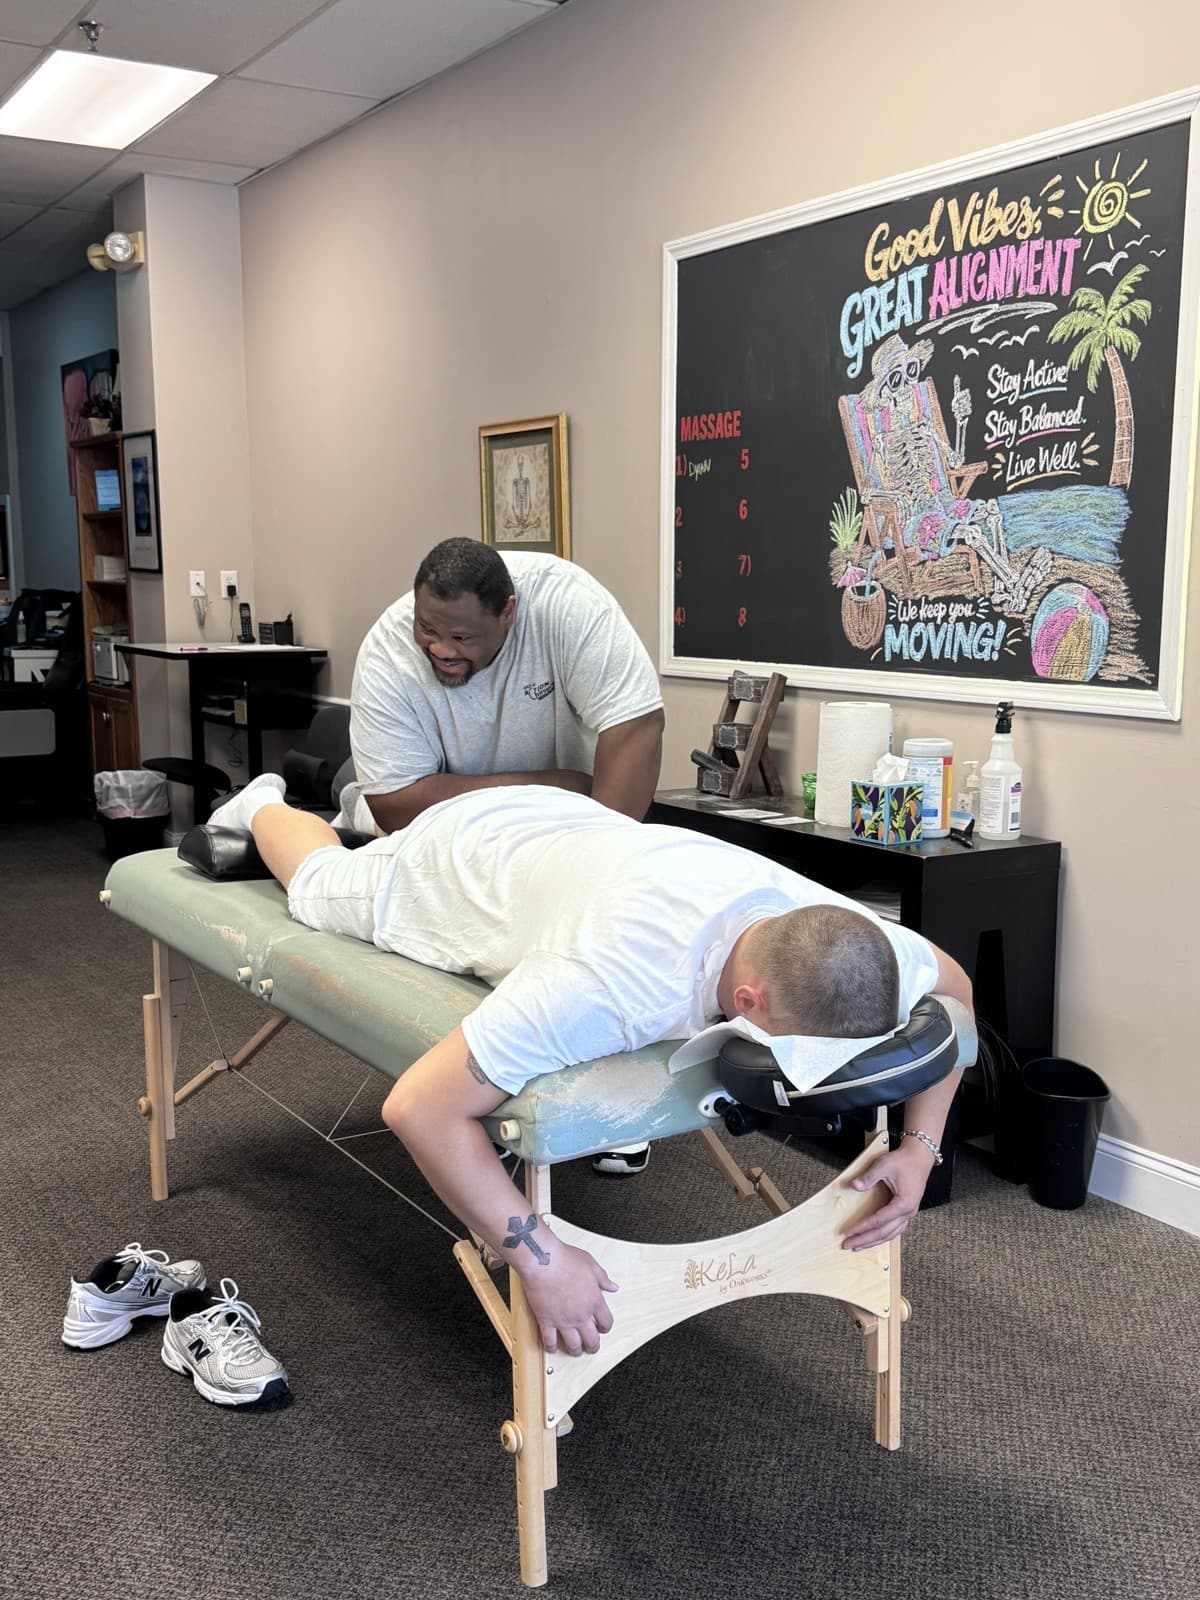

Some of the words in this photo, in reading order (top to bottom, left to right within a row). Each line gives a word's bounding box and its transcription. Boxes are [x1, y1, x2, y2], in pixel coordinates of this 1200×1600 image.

[864, 198, 946, 282] Good
[947, 187, 1042, 252] Vibes,
[840, 264, 929, 379] GREAT
[928, 237, 1082, 321] ALIGNMENT
[986, 364, 1021, 405] Stay
[680, 410, 742, 442] MASSAGE
[984, 410, 1018, 448] Stay
[1018, 395, 1087, 435] Balanced.
[741, 449, 750, 470] 5
[1006, 451, 1036, 483] Live
[1038, 441, 1081, 473] Well.
[675, 506, 683, 527] 2
[739, 499, 748, 520] 6
[738, 554, 751, 576] 7)
[738, 607, 747, 627] 8
[898, 599, 918, 622] We
[919, 596, 947, 625] keep
[948, 602, 976, 624] you
[884, 619, 1007, 663] MOVING!
[700, 1252, 757, 1286] KeLa
